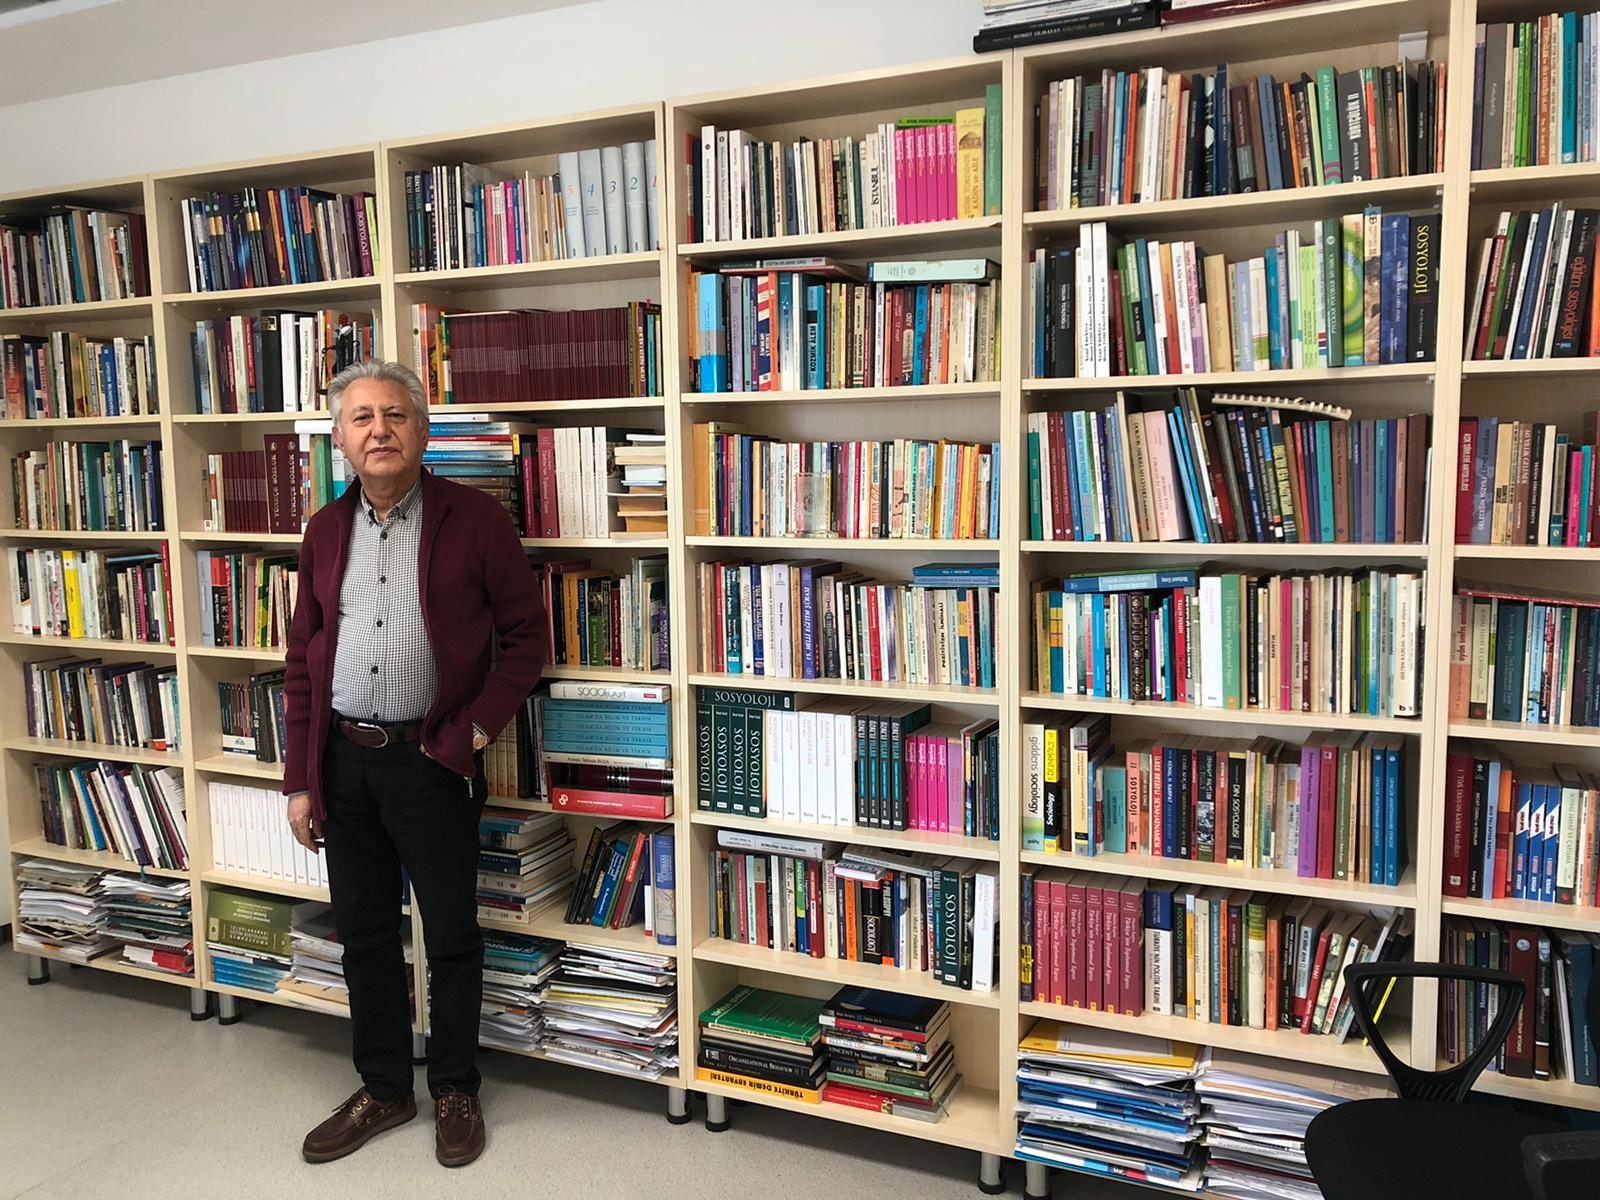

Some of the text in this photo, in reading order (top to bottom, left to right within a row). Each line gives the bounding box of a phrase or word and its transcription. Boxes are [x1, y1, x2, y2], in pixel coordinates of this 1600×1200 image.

[587, 184, 594, 196] 4
[609, 180, 616, 193] 3
[630, 176, 638, 190] 2
[870, 165, 879, 204] İSTANBUL
[1414, 225, 1429, 293] SOSYOLOJİ
[1559, 255, 1585, 340] eğitim sosyolojisi
[714, 688, 776, 708] SOSYOLOJİ
[698, 725, 711, 791] SOSYOLOJİ
[715, 726, 728, 792] SOSYOLOJİ
[732, 728, 744, 794] SOSYOLOJİ
[748, 729, 761, 797] SOSYOLOJİ
[1029, 736, 1040, 814] giddens sociology
[1046, 792, 1055, 824] Sociology
[882, 886, 891, 917] PHILOSOPHY
[867, 917, 876, 951] SOCIOLOGY
[944, 893, 958, 965] SOSYOLOJİ
[836, 1065, 854, 1075] ALAIN
